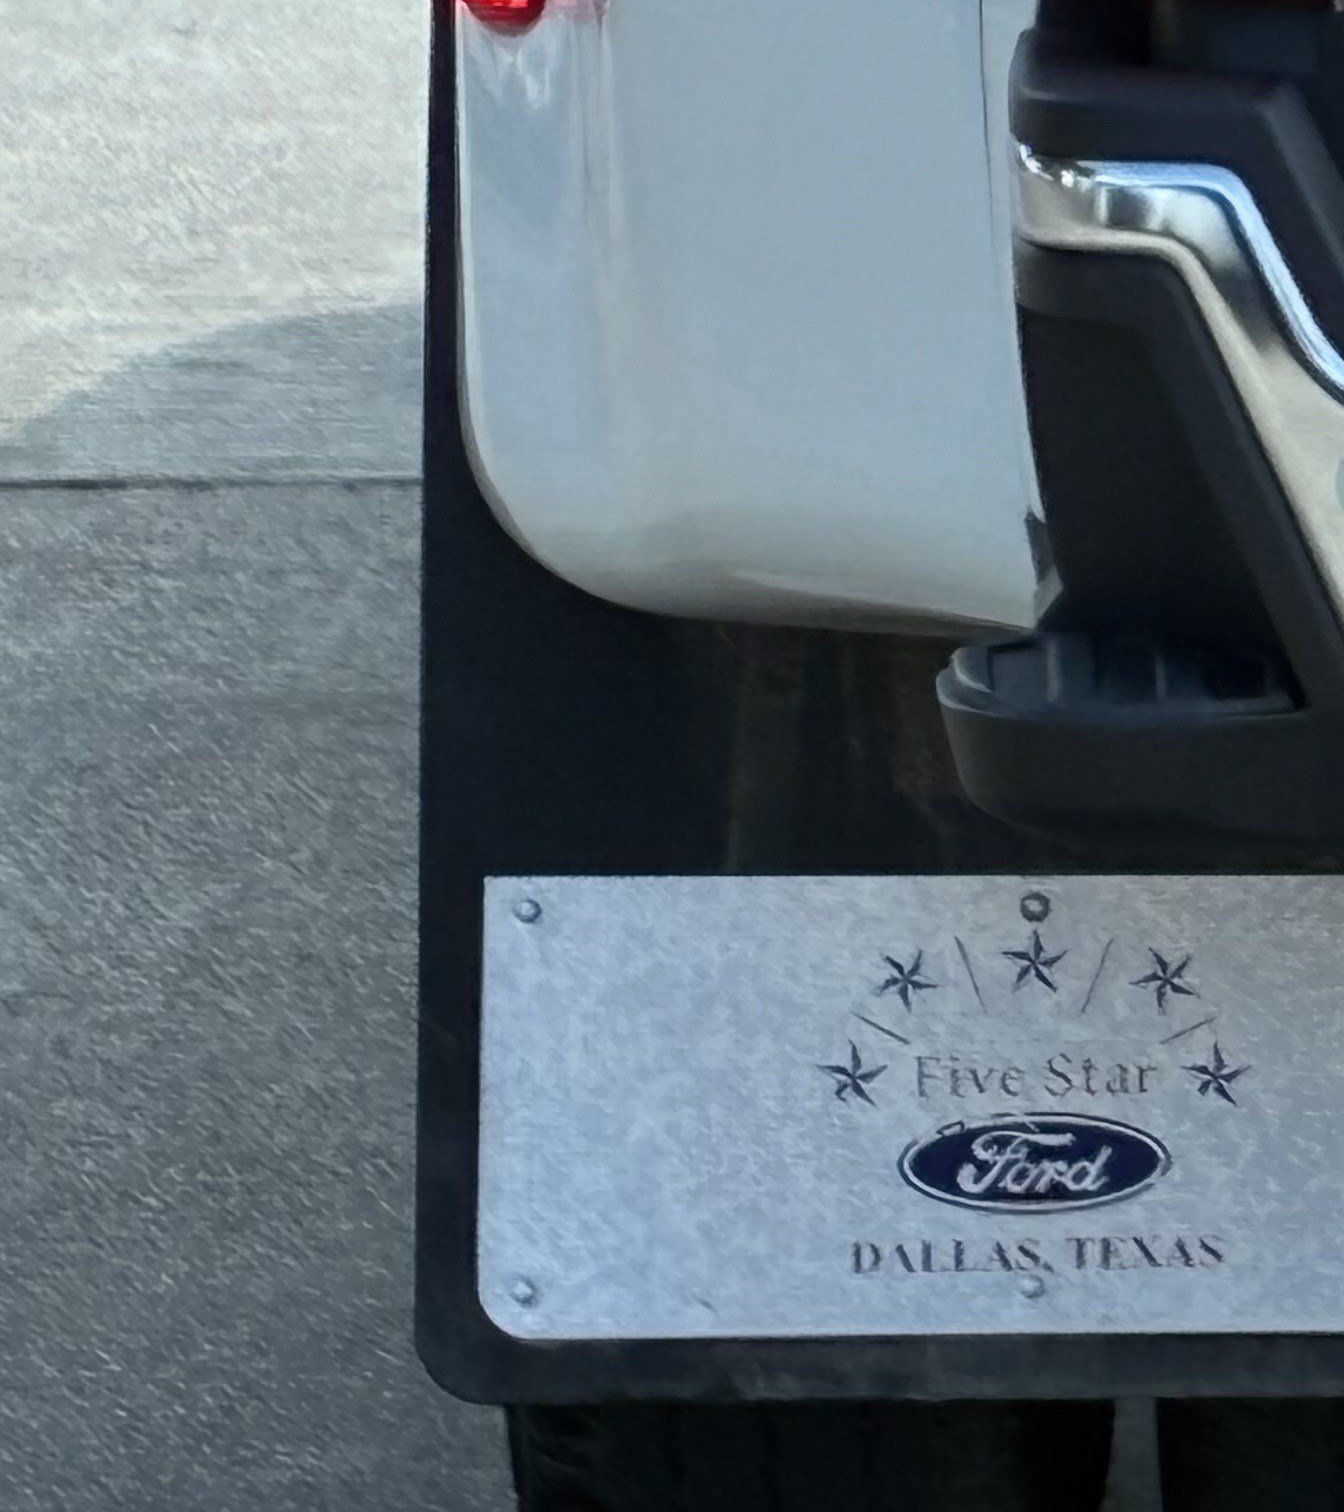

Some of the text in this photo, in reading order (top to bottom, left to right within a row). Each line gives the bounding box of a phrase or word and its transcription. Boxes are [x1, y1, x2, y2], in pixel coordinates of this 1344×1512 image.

[915, 1052, 1157, 1098] Five Star
[956, 1130, 1116, 1194] Ford
[1065, 1235, 1224, 1271] TEXAS
